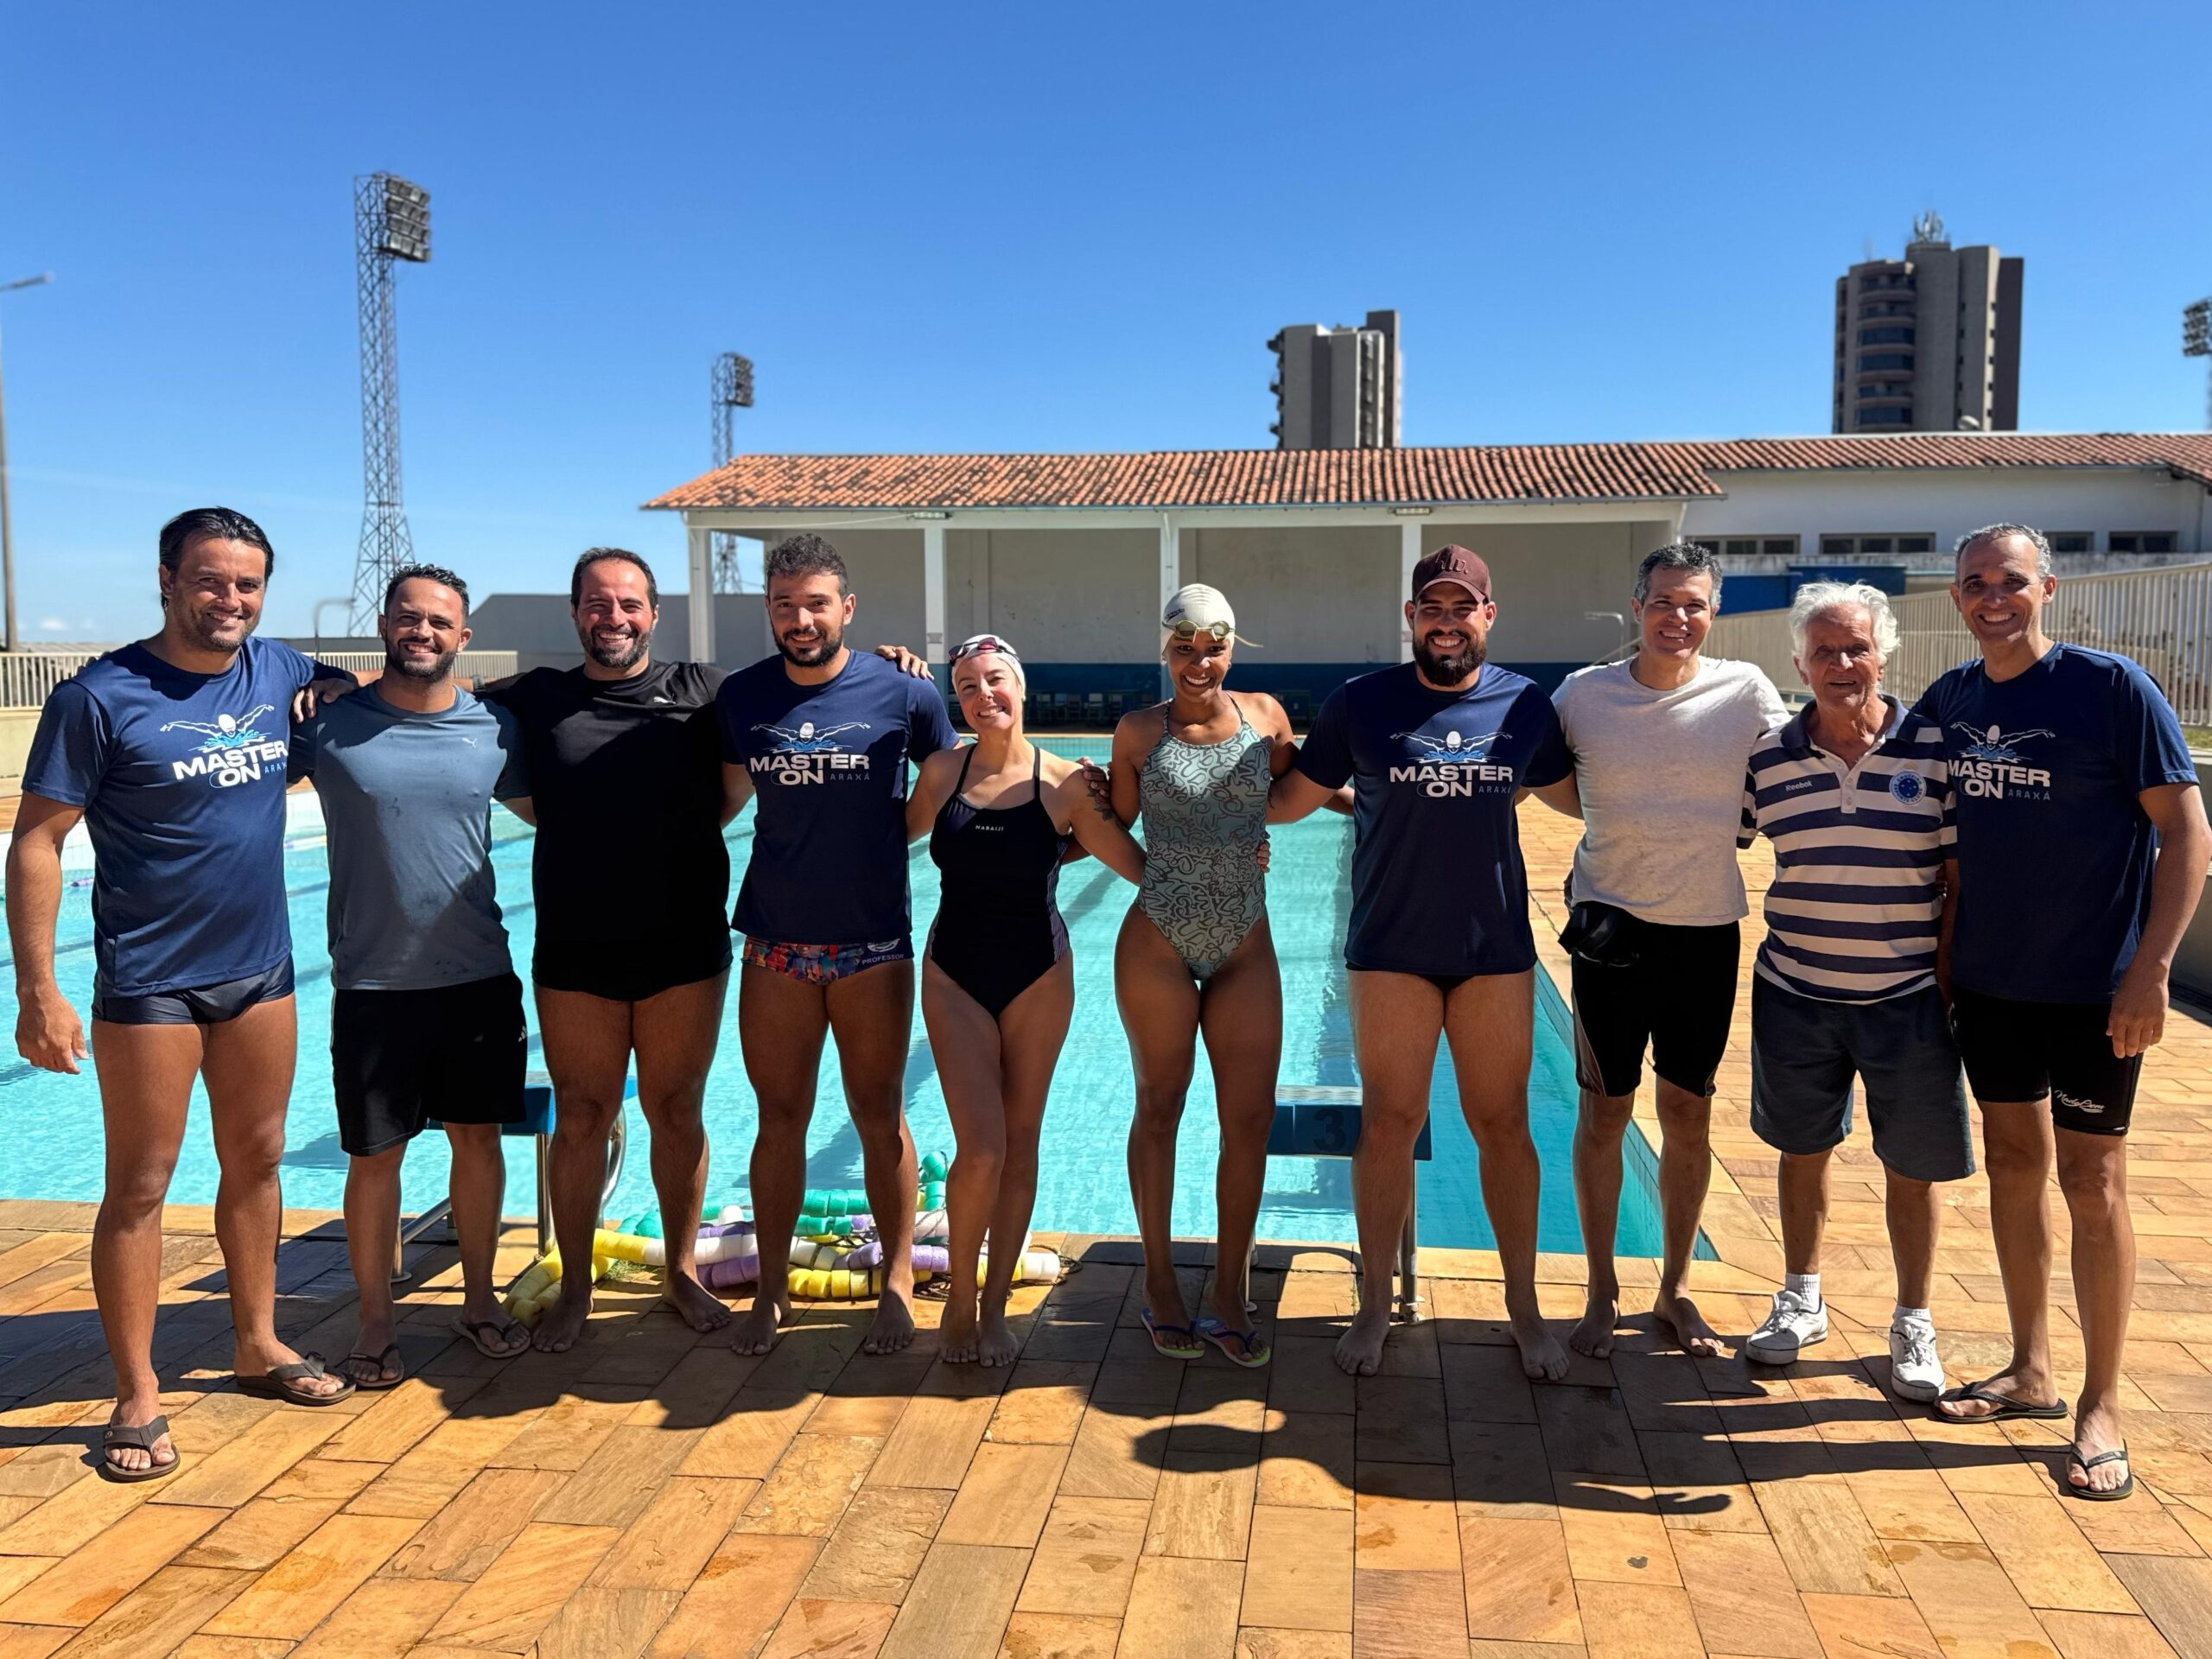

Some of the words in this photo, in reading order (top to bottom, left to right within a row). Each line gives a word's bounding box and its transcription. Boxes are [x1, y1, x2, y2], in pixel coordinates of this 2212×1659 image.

[173, 741, 288, 779] MASTER
[750, 753, 870, 772] MASTER
[218, 763, 261, 787] ON
[264, 761, 287, 774] ARAX
[779, 770, 823, 785] ON
[830, 772, 870, 781] ARAXÁ
[1389, 765, 1513, 783] MASTER
[1948, 760, 2050, 787] MASTER
[1427, 781, 1472, 798] ON
[1785, 780, 1813, 792] Reebok
[1964, 779, 2004, 799] ON
[2007, 788, 2050, 801] ARAXÁ
[861, 954, 905, 965] PROFESSOR
[1313, 1109, 1346, 1153] 3
